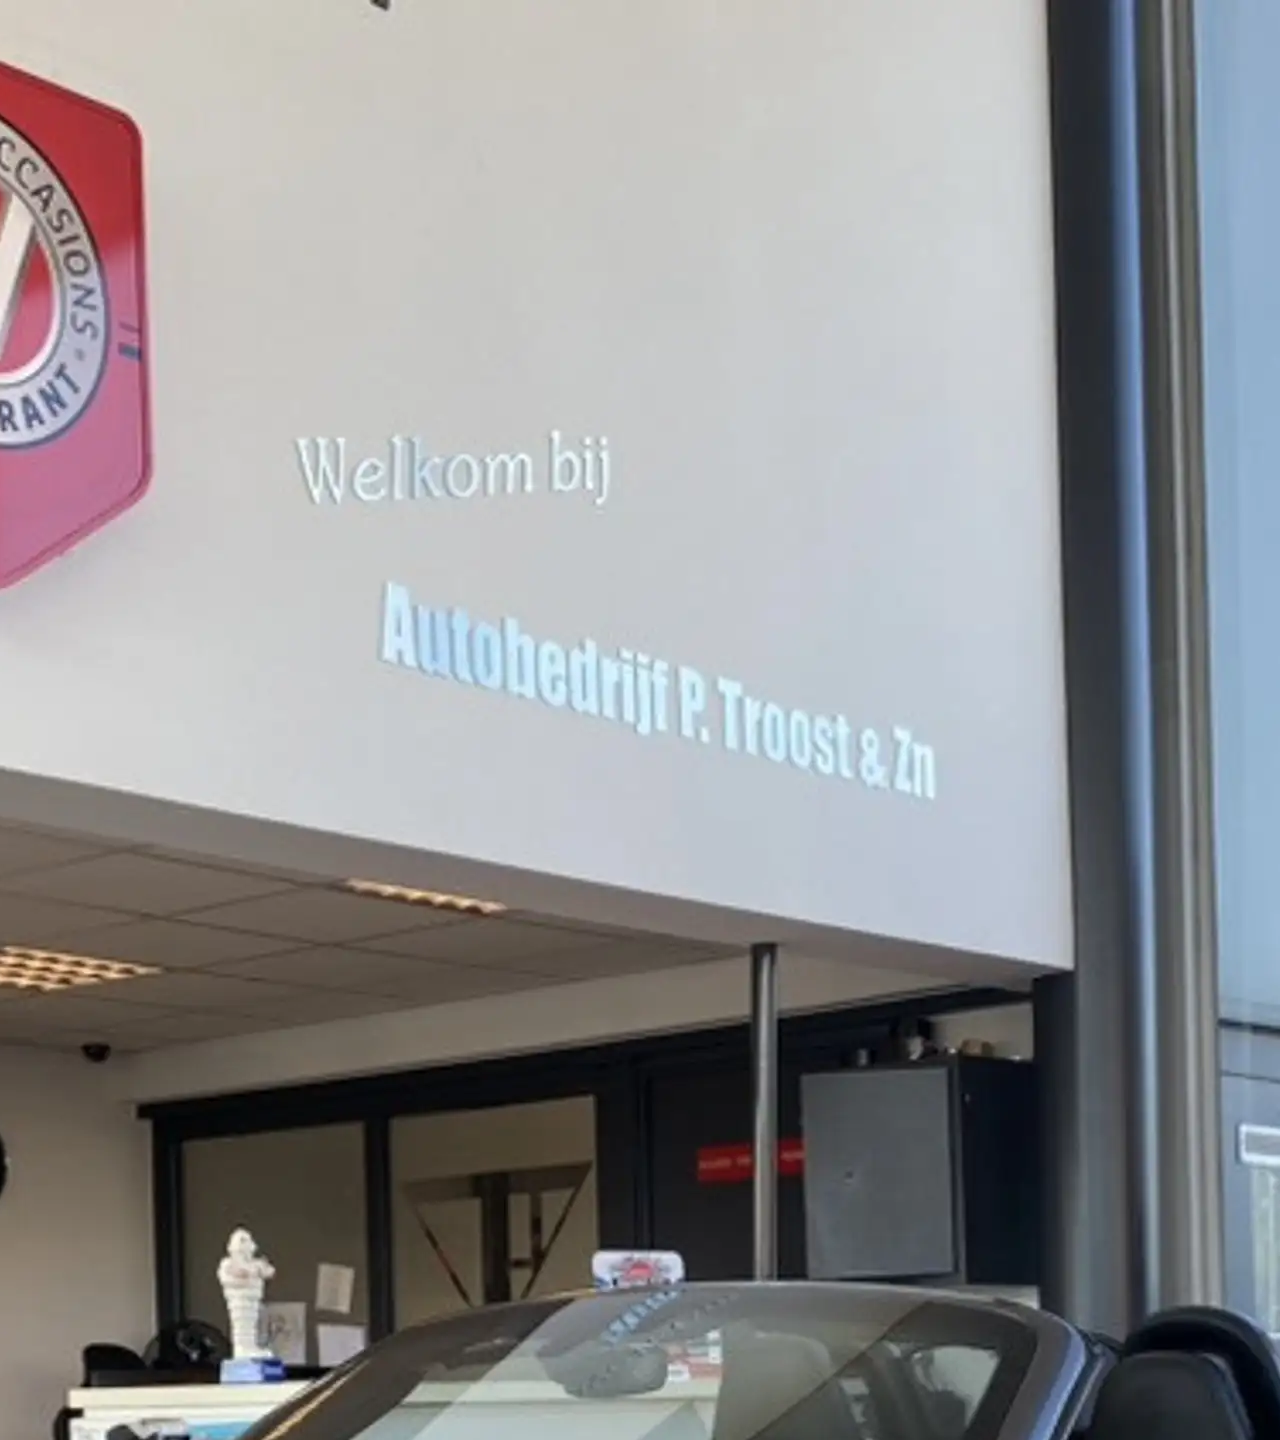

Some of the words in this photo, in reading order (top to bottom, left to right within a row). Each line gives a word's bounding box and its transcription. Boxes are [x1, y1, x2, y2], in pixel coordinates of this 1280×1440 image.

[295, 435, 534, 504] Welkom
[548, 430, 611, 504] bij
[380, 580, 669, 735] Autobedrijf
[678, 664, 711, 744] P.
[717, 677, 852, 781] Troost
[856, 727, 888, 790] &
[891, 725, 936, 800] Zn
